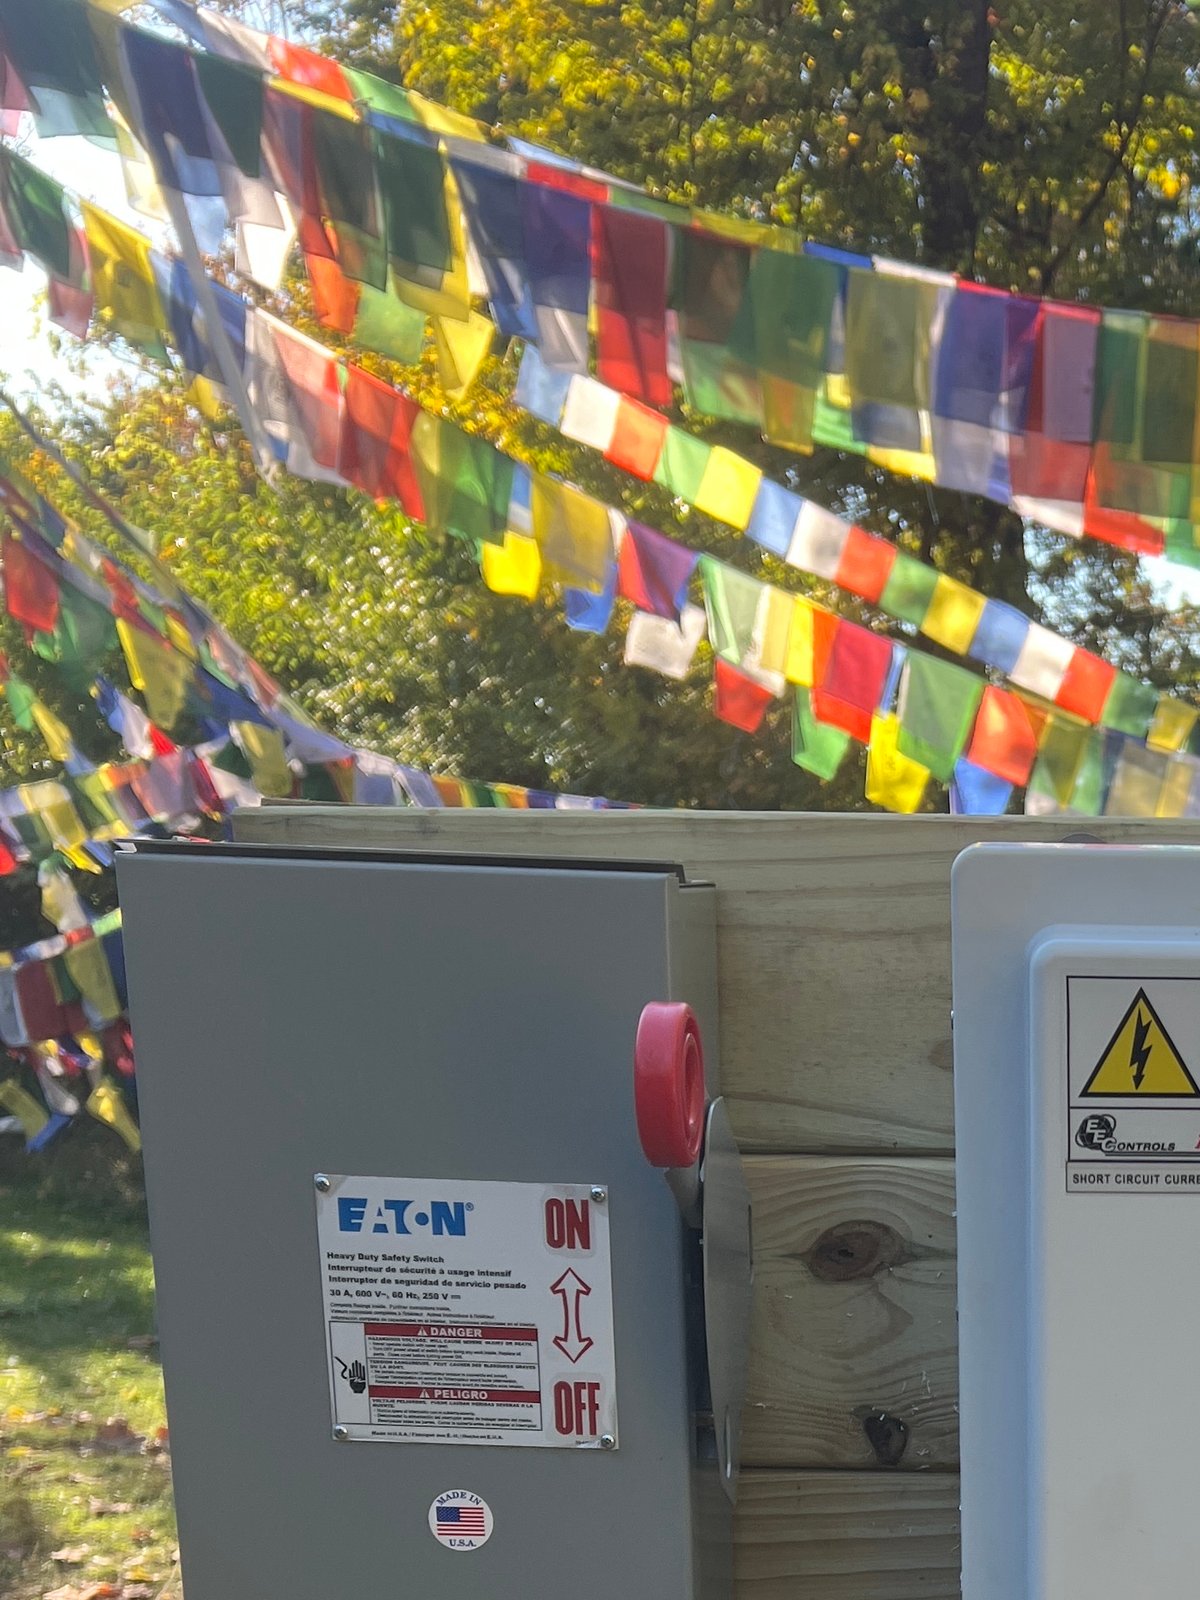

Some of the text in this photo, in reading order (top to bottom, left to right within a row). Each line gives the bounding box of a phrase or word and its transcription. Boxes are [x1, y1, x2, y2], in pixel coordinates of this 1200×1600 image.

[1072, 1174, 1111, 1184] SHORT
[1117, 1174, 1160, 1184] CIRCUIT
[545, 1198, 591, 1250] ON
[327, 1252, 444, 1263] Heavy Duty Safety Switch
[328, 1264, 382, 1274] Interrupteur
[385, 1265, 396, 1273] de
[447, 1269, 475, 1277] usage
[477, 1269, 512, 1277] intensif
[328, 1275, 527, 1290] Interruptor de seguridad de servicio pesado
[343, 1289, 353, 1298] A,
[422, 1292, 439, 1300] 250
[431, 1327, 482, 1338] DANGER
[434, 1389, 488, 1400] PELIGRO
[553, 1380, 601, 1436] OFF
[436, 1491, 482, 1506] MADE IN
[449, 1539, 477, 1547] U.S.A.
